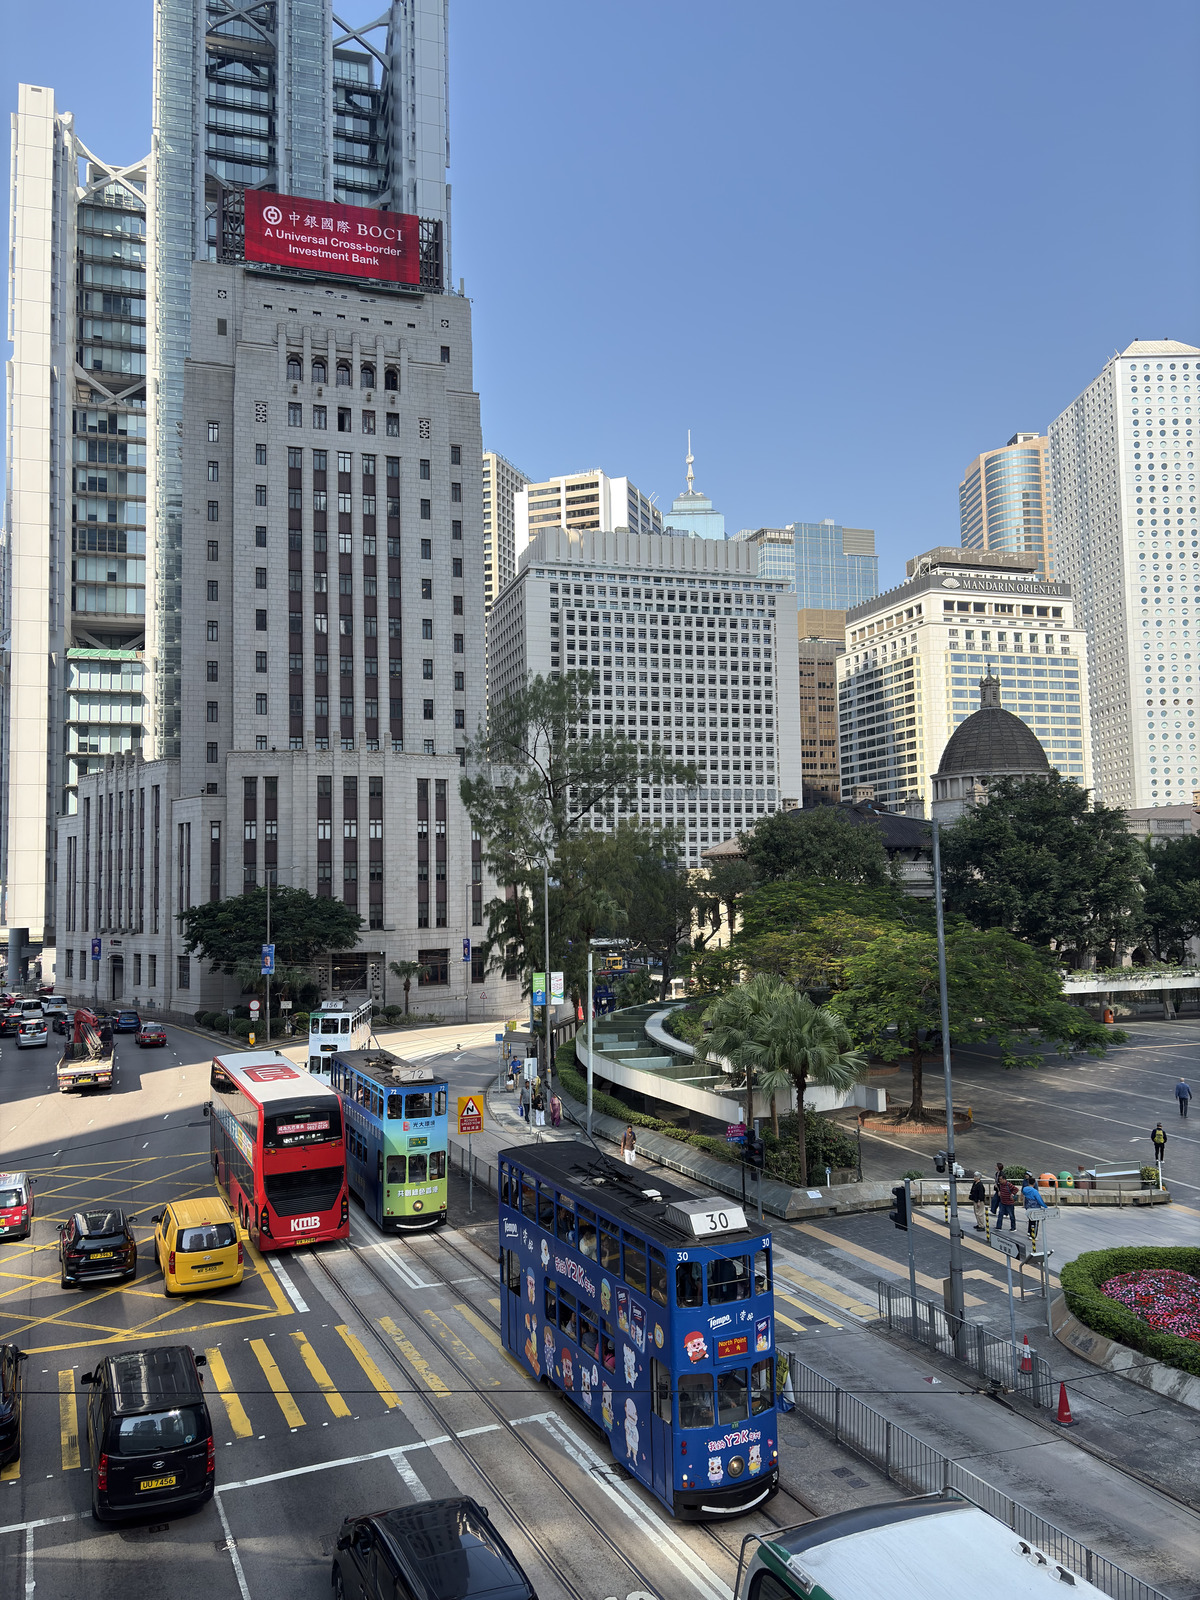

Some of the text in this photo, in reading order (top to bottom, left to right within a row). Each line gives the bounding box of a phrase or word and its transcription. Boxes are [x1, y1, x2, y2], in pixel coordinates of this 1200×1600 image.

[288, 211, 403, 241] 中銀國際 BOCI
[264, 228, 402, 257] A Universal Cross-border
[288, 244, 379, 266] Investment Bank
[962, 579, 1063, 595] MANDARIN ORIENTAL
[410, 1070, 424, 1079] 72
[290, 1216, 321, 1232] KMB
[503, 1217, 518, 1236] Tempo
[706, 1212, 729, 1231] 30
[762, 1238, 770, 1248] 30
[676, 1252, 689, 1261] 30
[707, 1314, 732, 1330] Tempo
[718, 1337, 747, 1347] North Point
[142, 1477, 174, 1488] UU 7456
